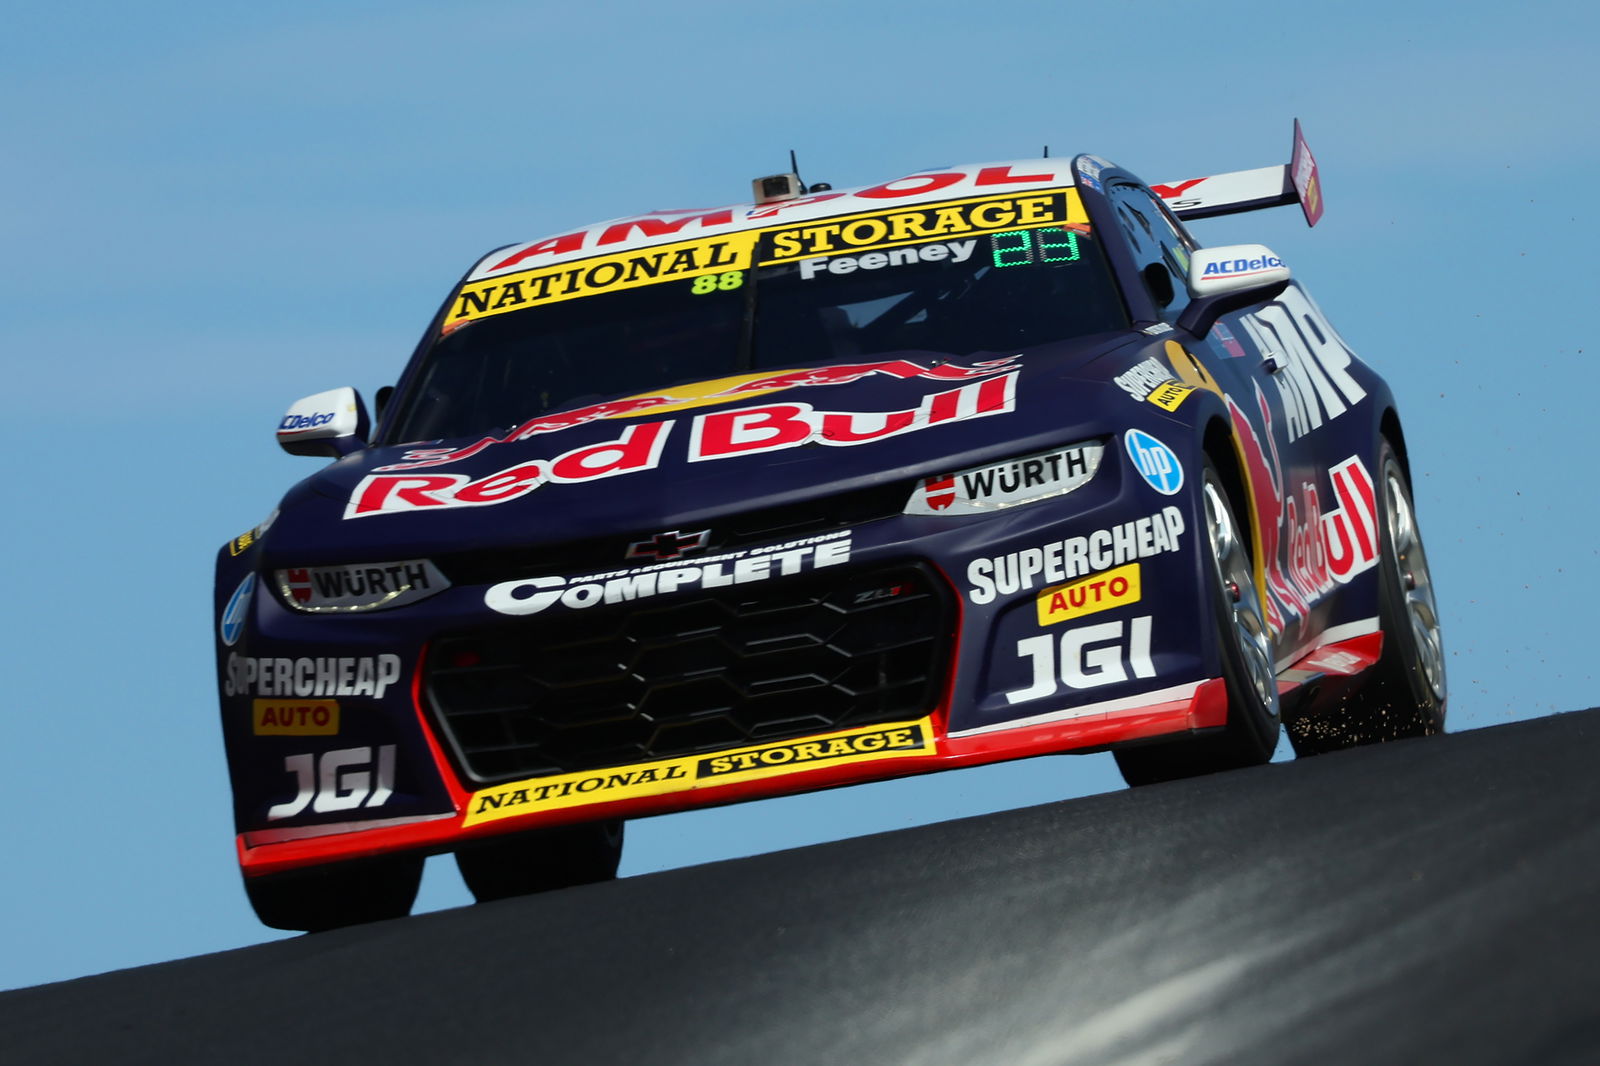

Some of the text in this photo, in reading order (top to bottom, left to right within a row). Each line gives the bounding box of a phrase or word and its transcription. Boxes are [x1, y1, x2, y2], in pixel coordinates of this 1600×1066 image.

[456, 196, 1054, 318] NATIONAL STORAGE
[691, 271, 743, 295] 88
[800, 239, 978, 280] Feeney
[1157, 387, 1183, 406] AUTO
[343, 370, 1020, 520] Red Bull
[1129, 432, 1174, 493] hp
[963, 448, 1087, 500] WÜRTH
[315, 563, 429, 598] WÜRTH
[484, 539, 852, 615] COMPLETE
[967, 505, 1185, 605] SUPERCHEAP
[1048, 577, 1129, 614] AUTO
[224, 652, 400, 699] SUPERCHEAP
[1005, 616, 1157, 704] JGI
[261, 706, 330, 727] AUTO
[267, 744, 396, 822] JGI
[476, 728, 915, 813] NATIONAL STORAGE
